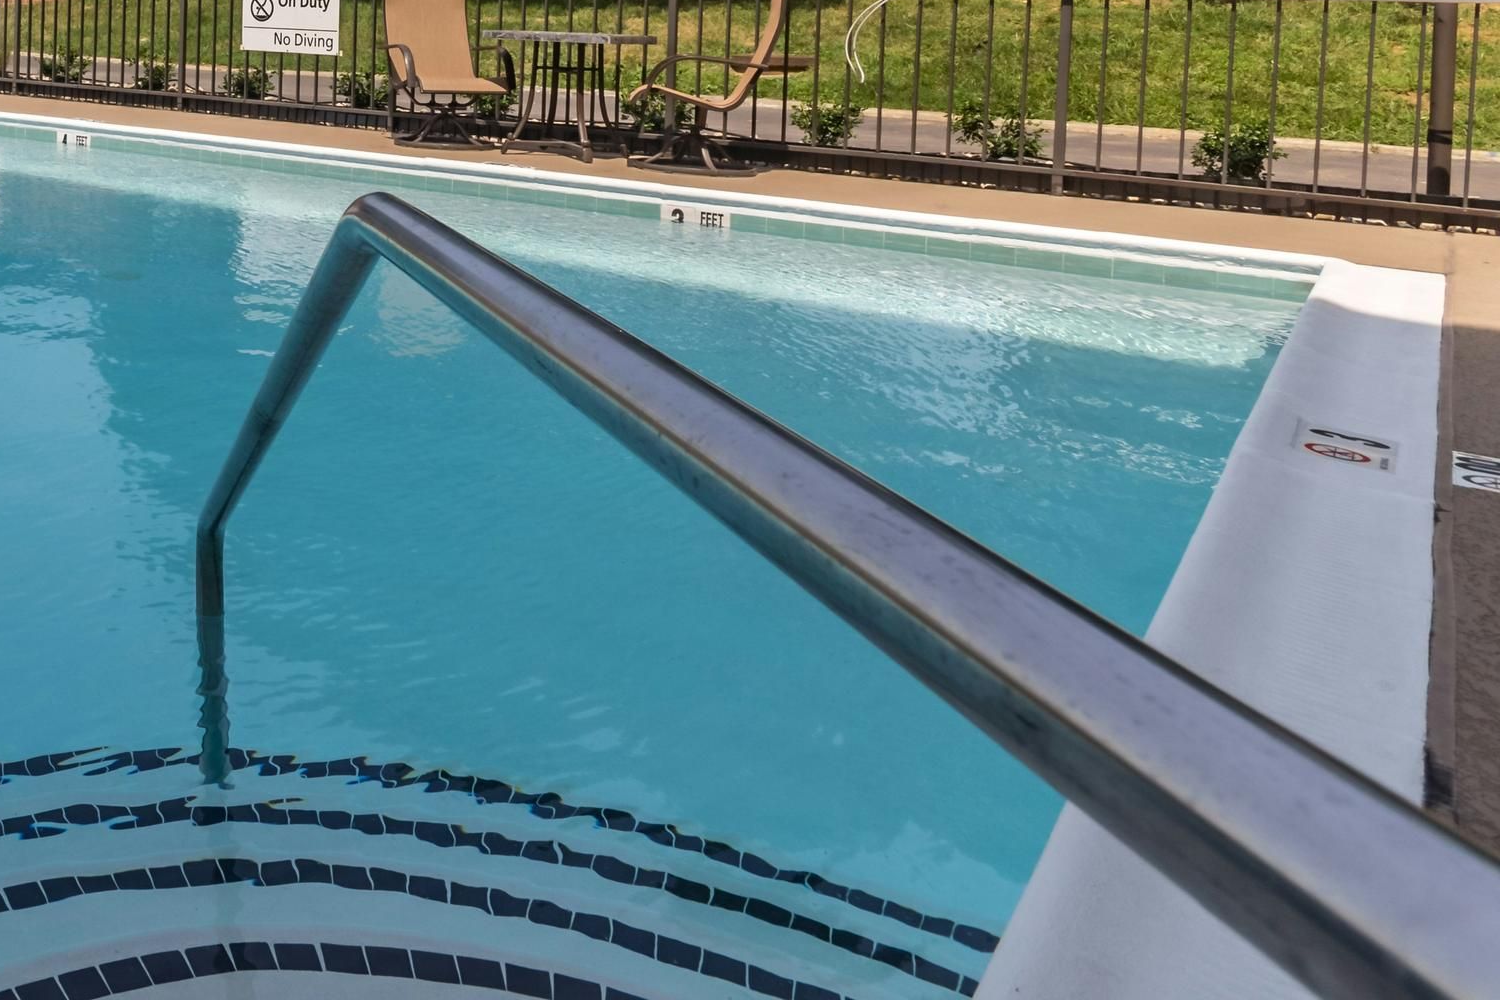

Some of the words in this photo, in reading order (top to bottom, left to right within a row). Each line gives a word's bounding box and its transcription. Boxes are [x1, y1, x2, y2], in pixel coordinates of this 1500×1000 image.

[273, 32, 291, 46] No
[294, 33, 334, 52] Diving
[700, 211, 724, 228] FEET
